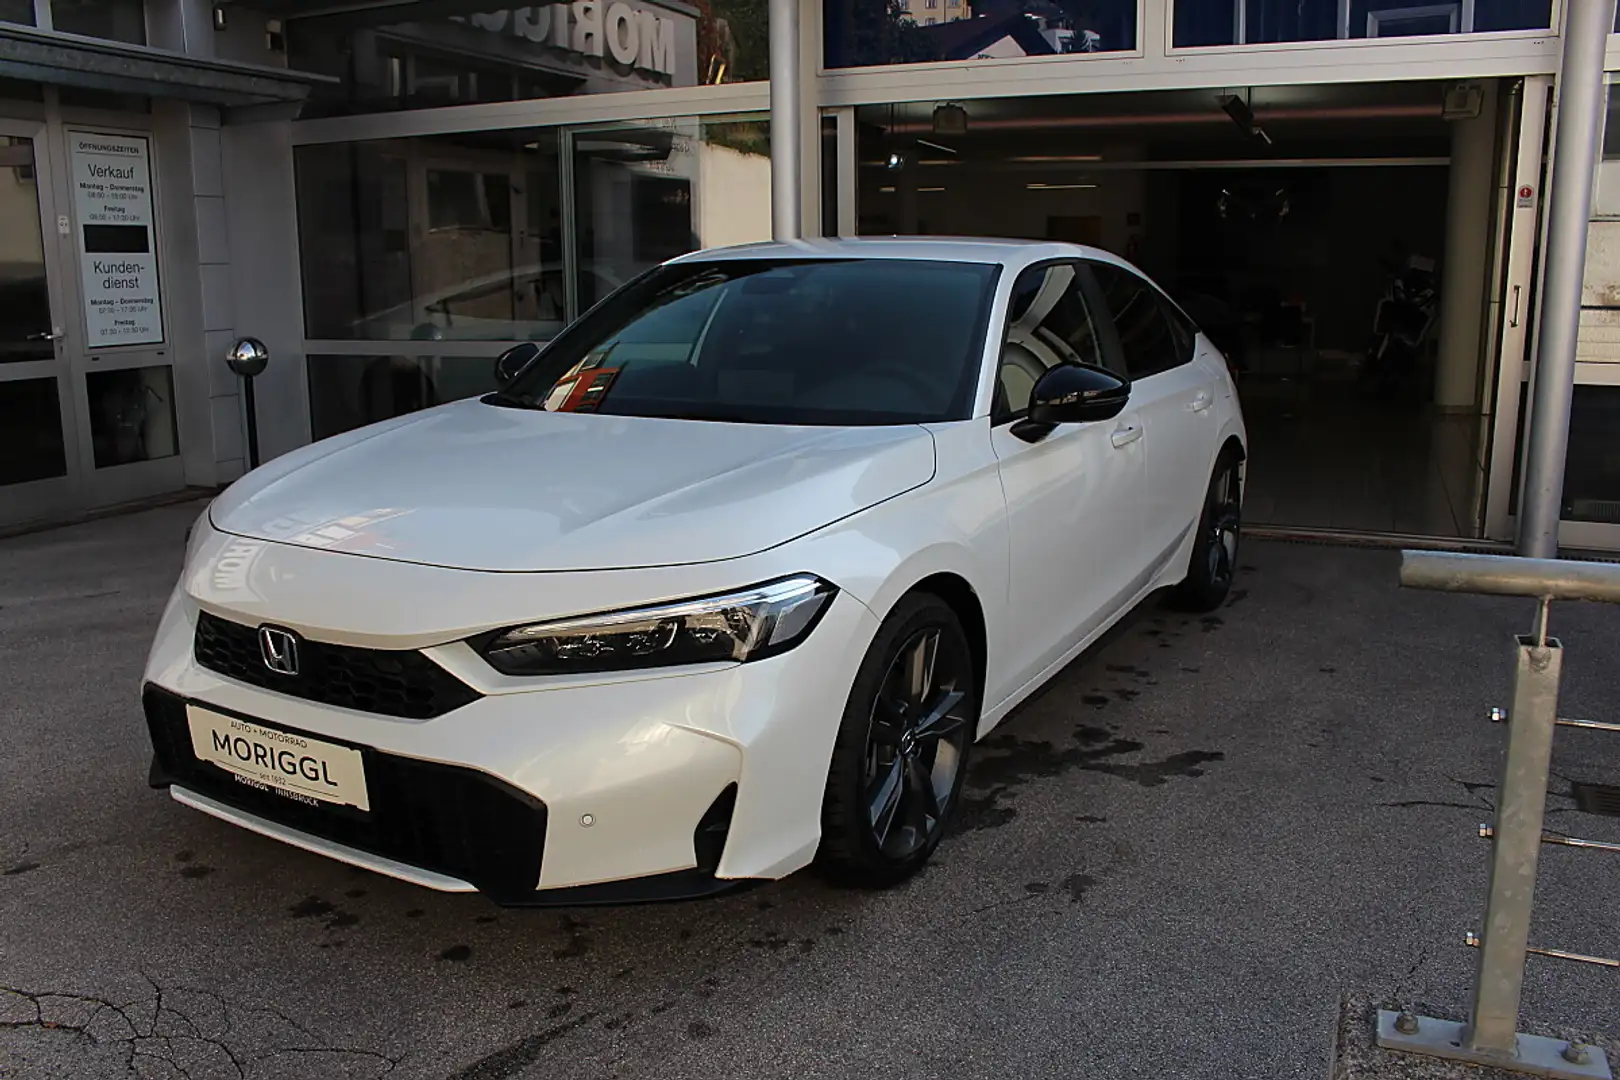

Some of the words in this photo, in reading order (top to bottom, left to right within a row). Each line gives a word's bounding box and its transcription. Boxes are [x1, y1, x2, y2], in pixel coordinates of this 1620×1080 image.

[78, 142, 139, 154] ÖFFNUNGSZEITEN
[88, 164, 134, 179] Verkauf
[80, 182, 104, 191] Montag
[110, 184, 144, 193] Donnerstag
[104, 205, 125, 214] Freitag
[93, 260, 145, 275] Kunden-
[102, 276, 139, 289] dienst
[120, 297, 154, 305] Donnerstag
[114, 319, 135, 327] Freitag
[230, 720, 251, 733] AUTO
[259, 728, 308, 749] MOTORRAD
[211, 729, 338, 787] MORIGGL
